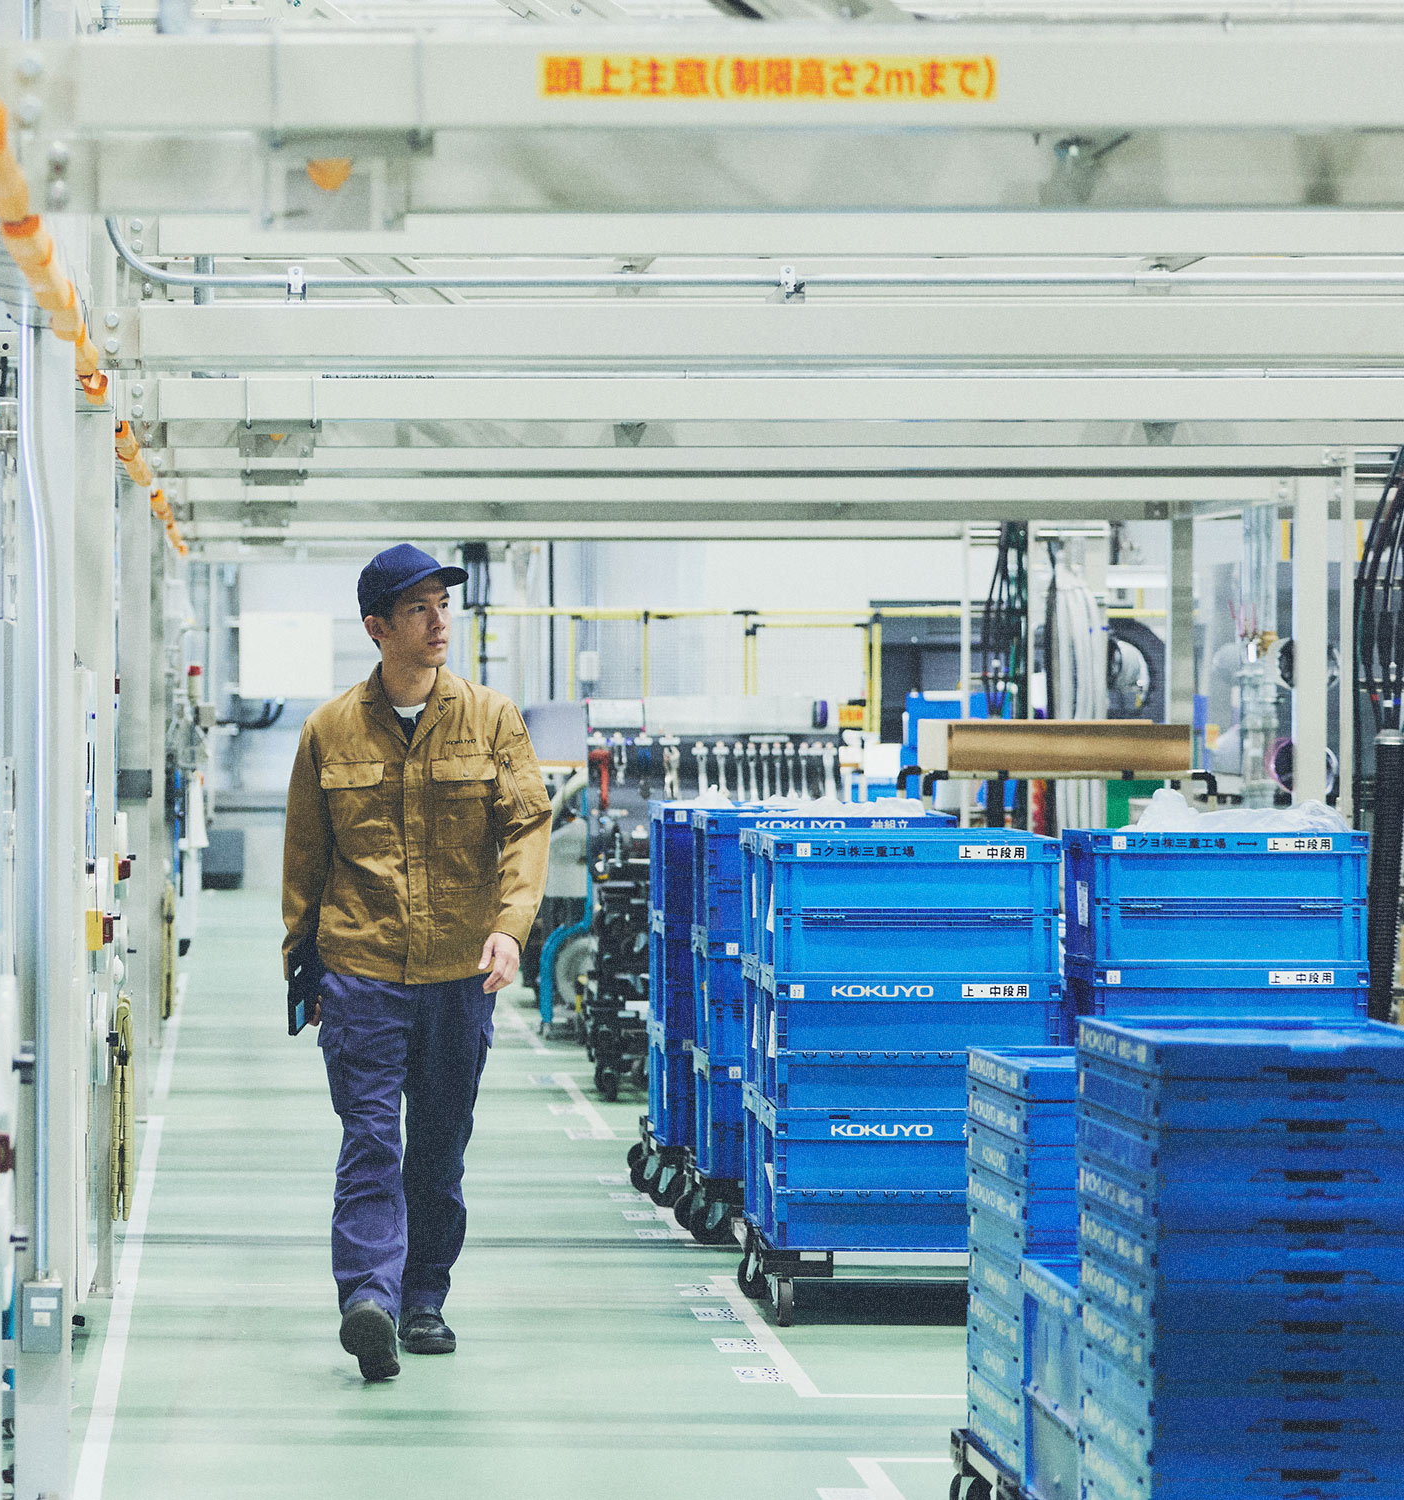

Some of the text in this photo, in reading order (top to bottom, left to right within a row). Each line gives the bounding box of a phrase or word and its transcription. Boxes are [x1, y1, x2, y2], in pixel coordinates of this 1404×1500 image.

[1268, 839, 1332, 851] 上・中段用
[960, 846, 1025, 859] 上・中段用
[1270, 972, 1333, 984] 上・中段用
[831, 984, 934, 998] KOKUYO
[963, 984, 1029, 998] 上・中段用
[830, 1124, 934, 1137] KOKUYO
